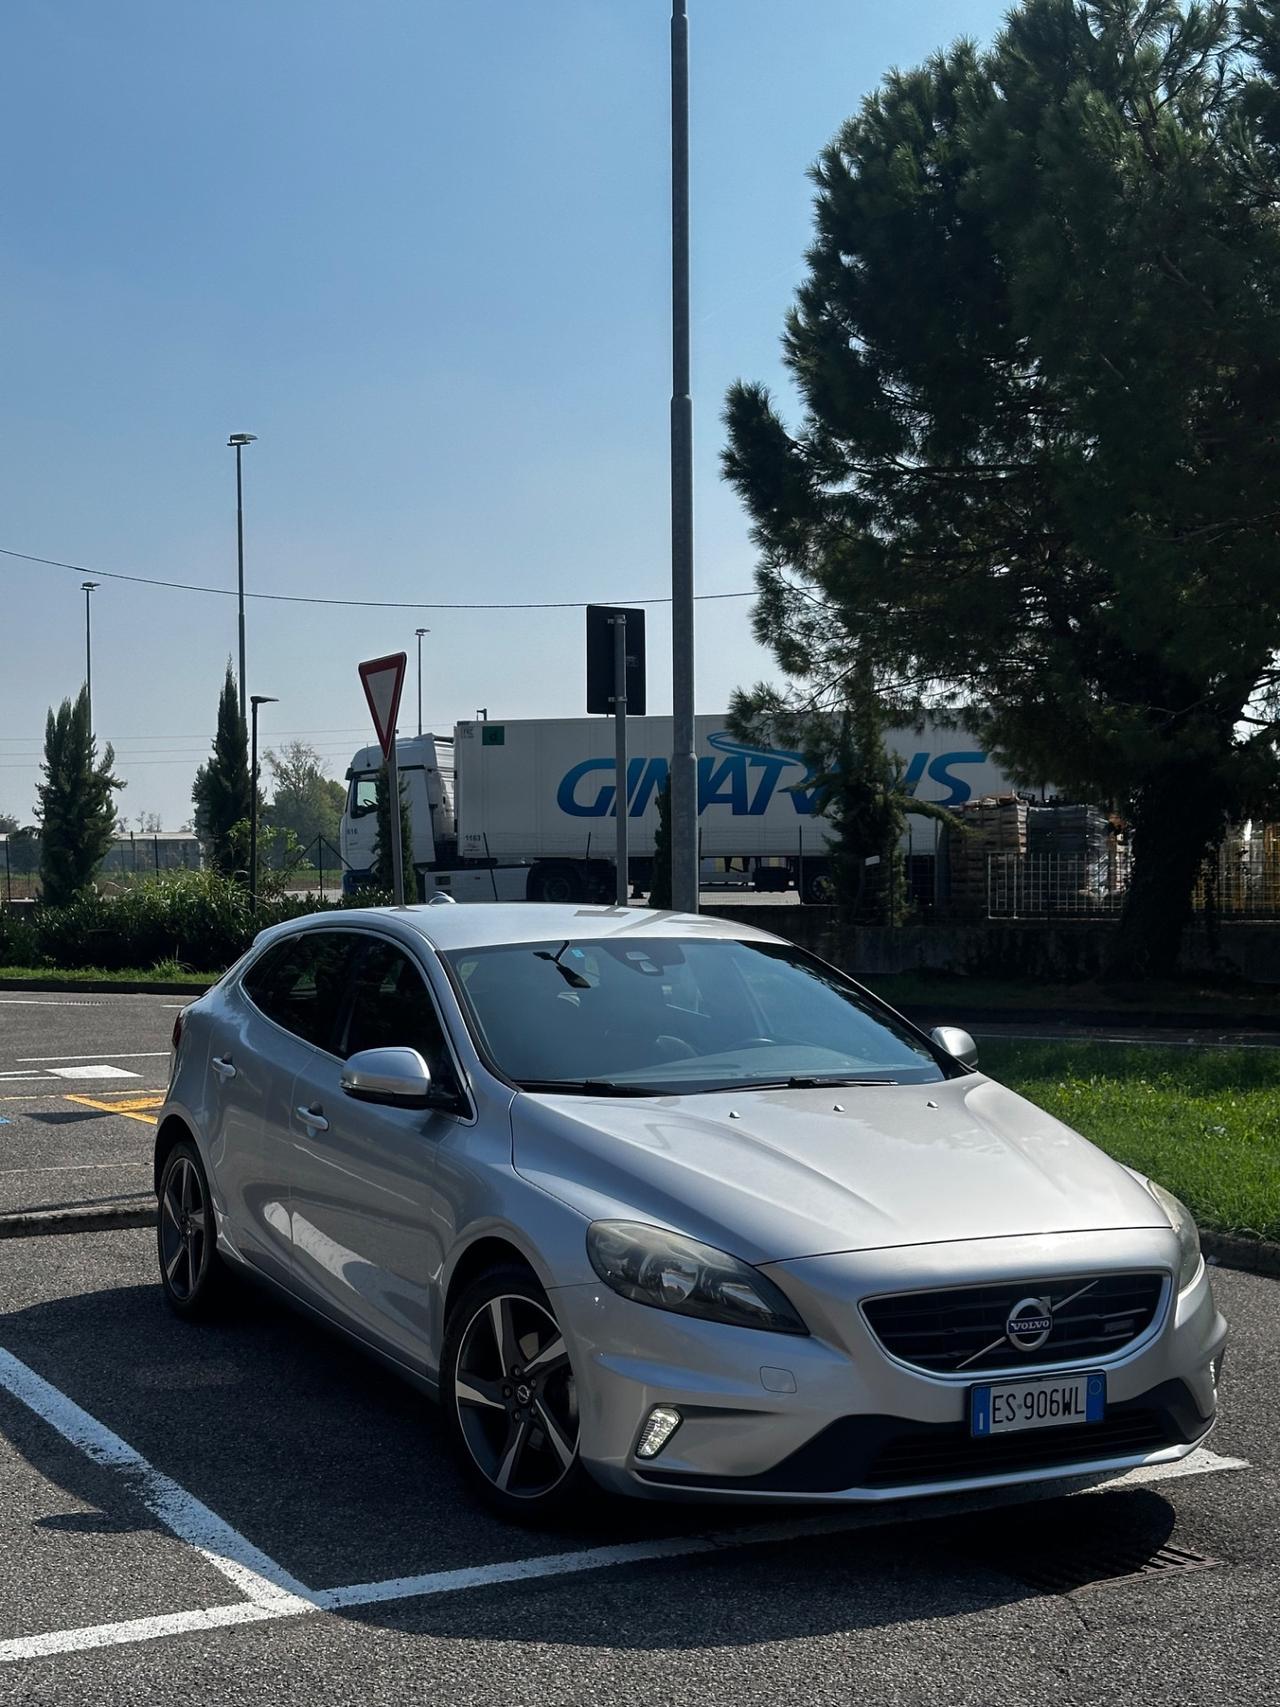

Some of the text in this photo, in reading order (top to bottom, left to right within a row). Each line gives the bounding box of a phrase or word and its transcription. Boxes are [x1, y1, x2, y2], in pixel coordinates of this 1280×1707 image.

[557, 751, 988, 817] GIMATRS
[1012, 1320, 1050, 1331] VOLVO
[992, 1386, 1085, 1424] ES 906WL
